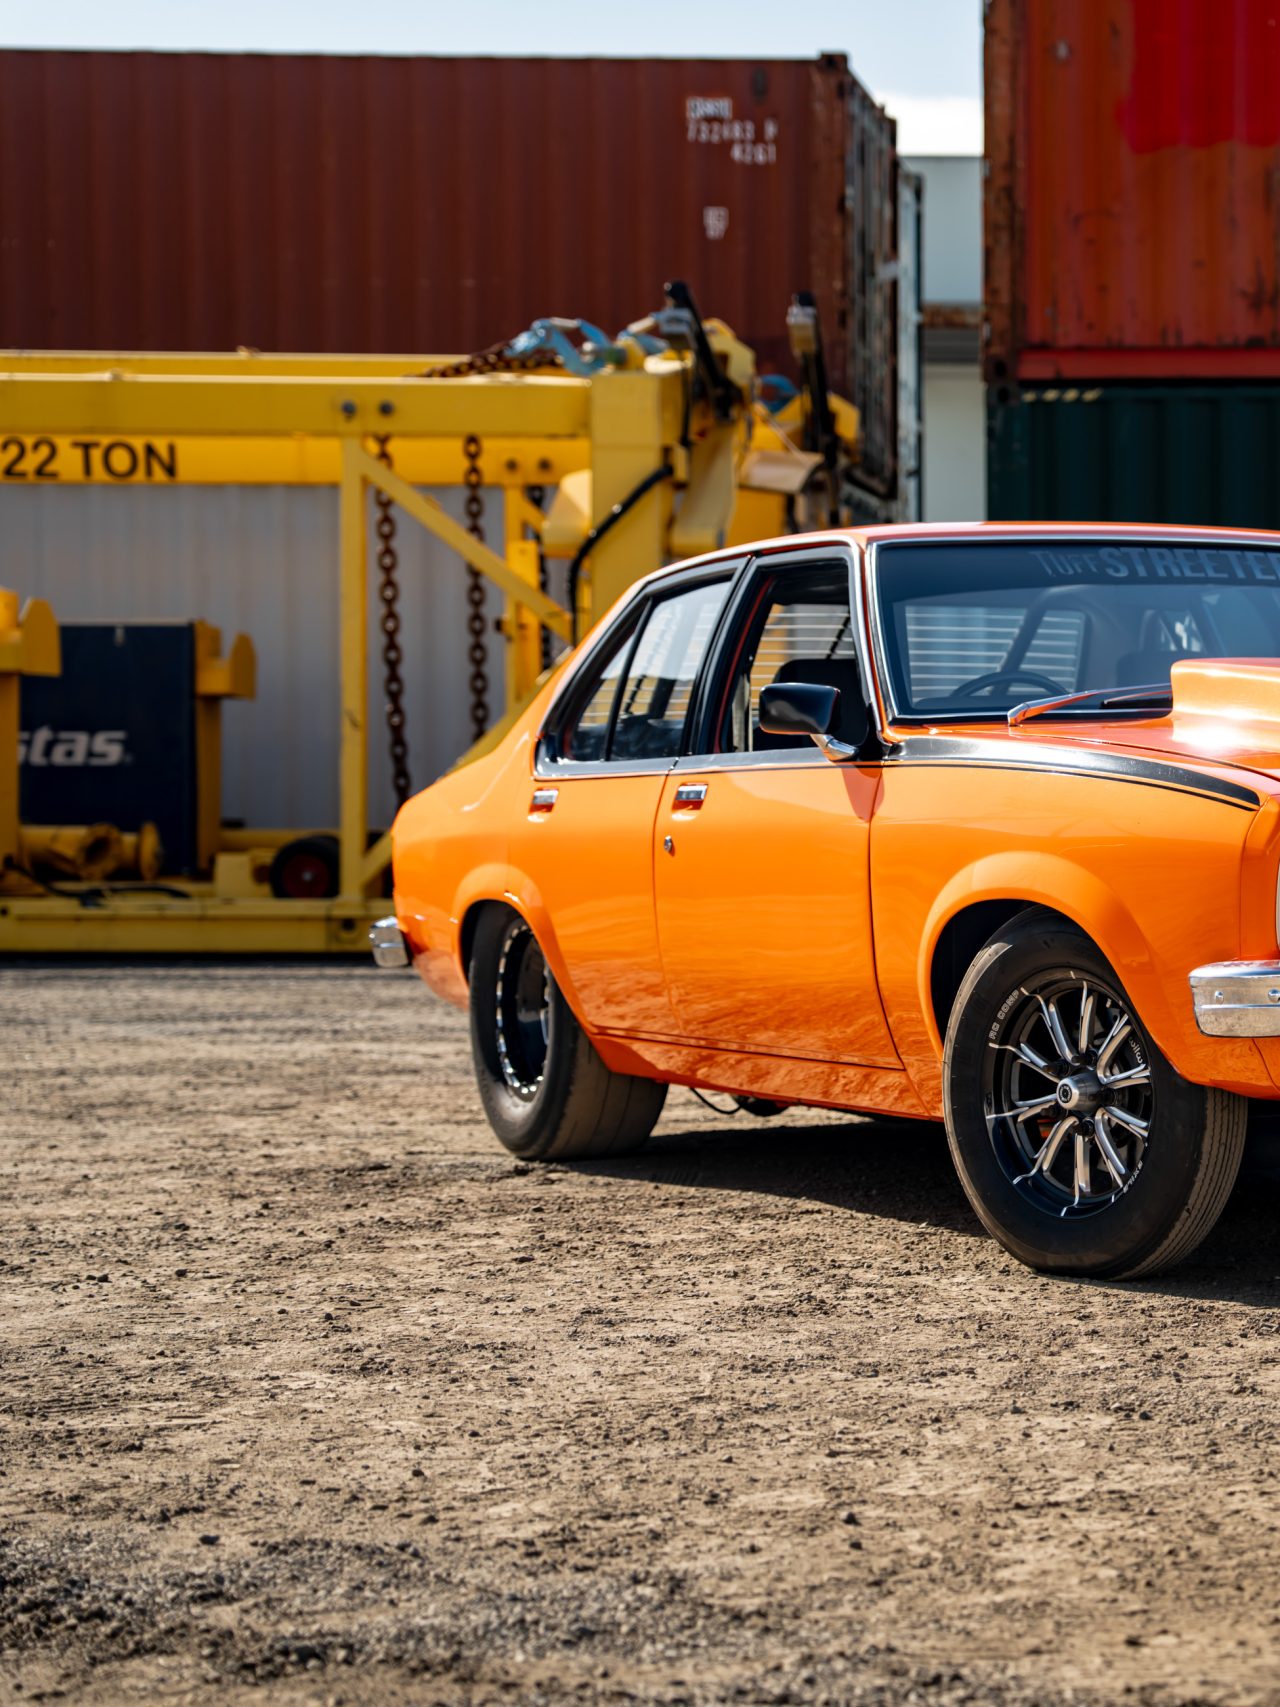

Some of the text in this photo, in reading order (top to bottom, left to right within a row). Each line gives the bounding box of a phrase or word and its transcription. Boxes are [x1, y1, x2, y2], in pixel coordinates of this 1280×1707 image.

[0, 436, 177, 479] 22 TON
[1030, 550, 1098, 577] TUFF
[997, 990, 1019, 1020] COMP
